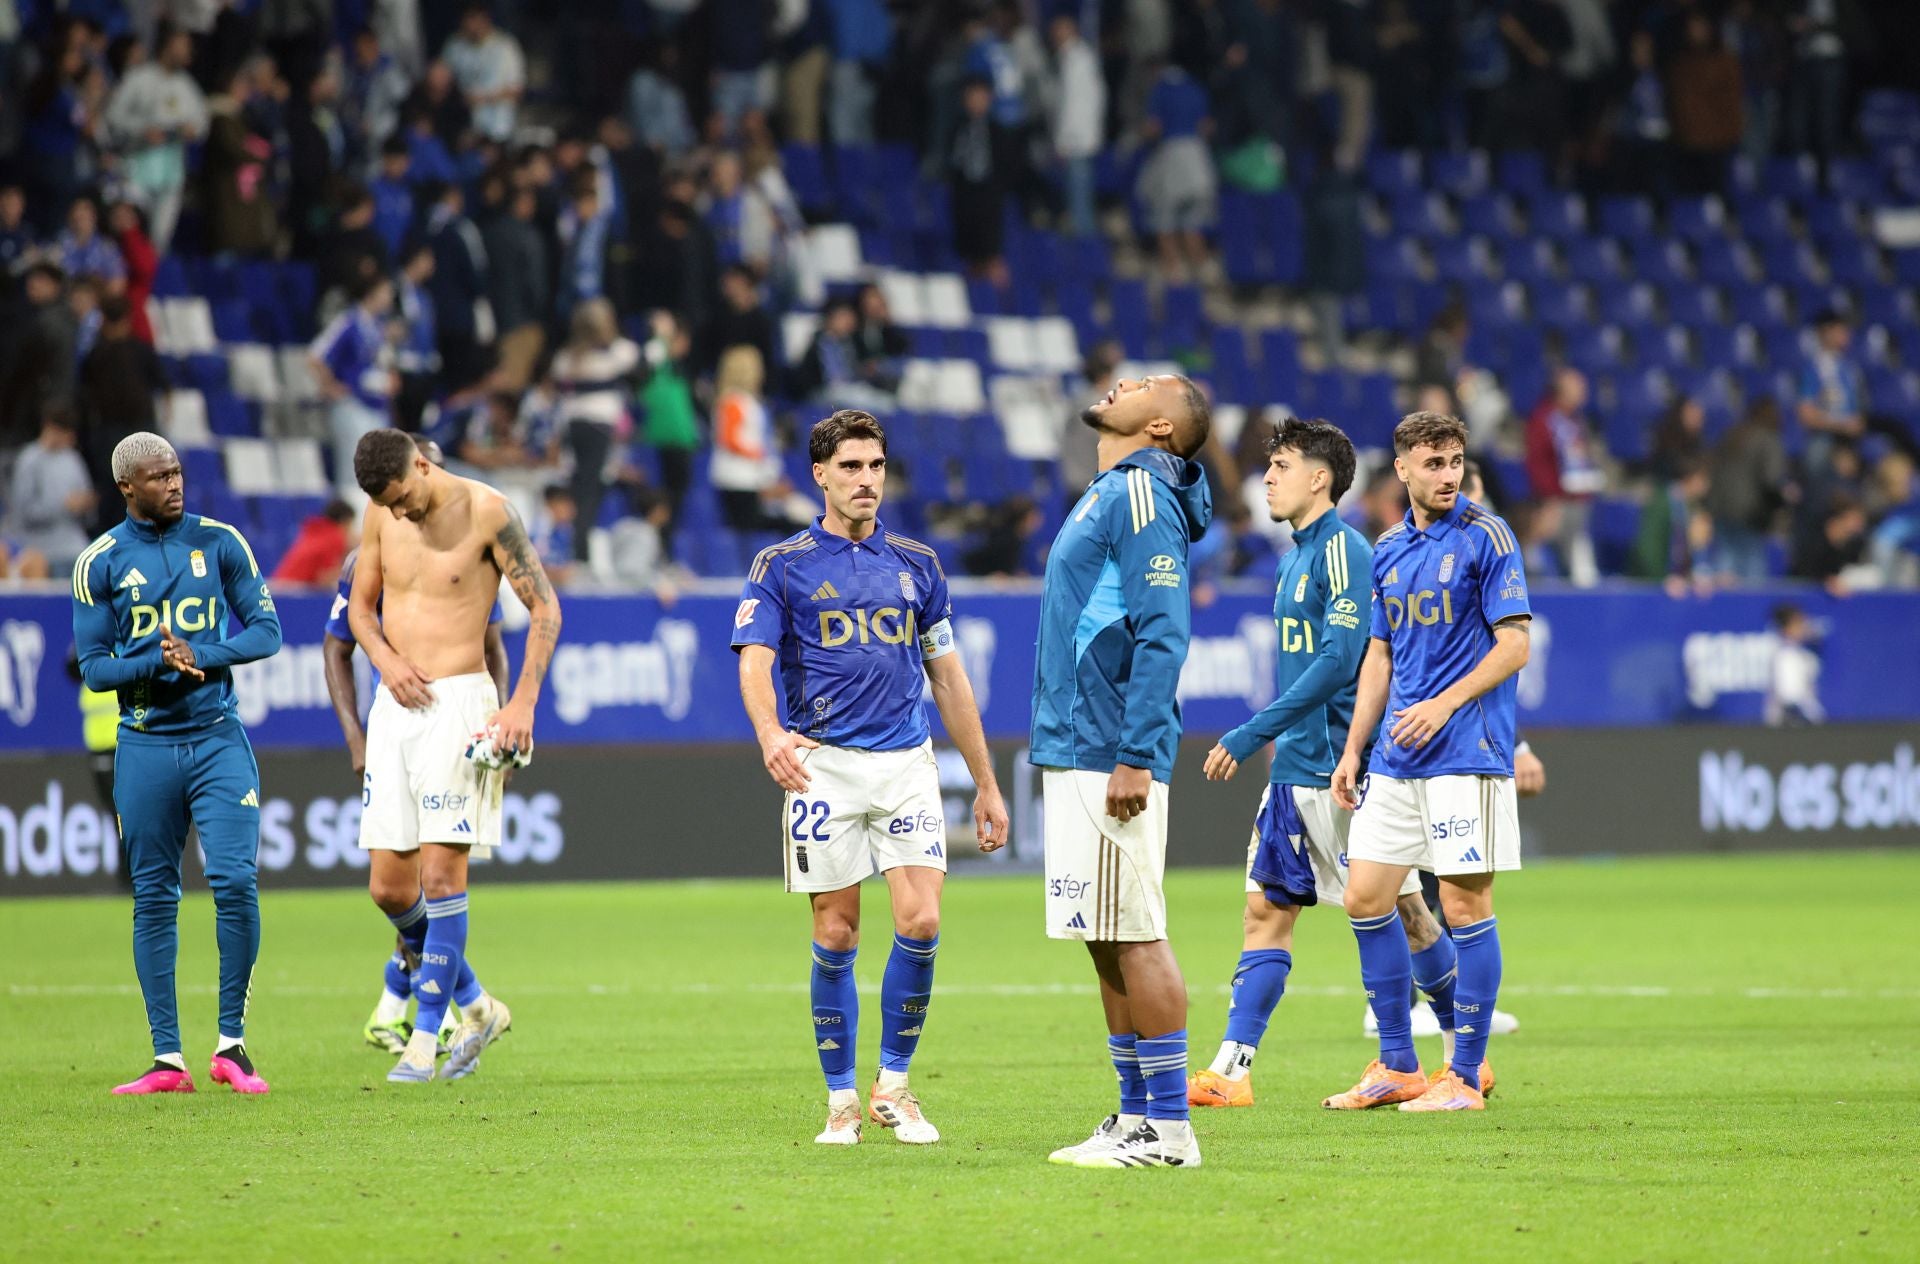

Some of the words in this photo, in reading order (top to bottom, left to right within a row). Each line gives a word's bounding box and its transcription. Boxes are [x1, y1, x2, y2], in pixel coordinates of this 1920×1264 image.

[131, 587, 140, 601] 6
[1384, 589, 1453, 631] DIGI
[131, 597, 216, 638] DIGI
[819, 607, 914, 647] DIGI
[423, 790, 471, 811] esfer
[1700, 749, 1774, 832] No
[792, 799, 831, 841] 22
[889, 810, 943, 834] esfer
